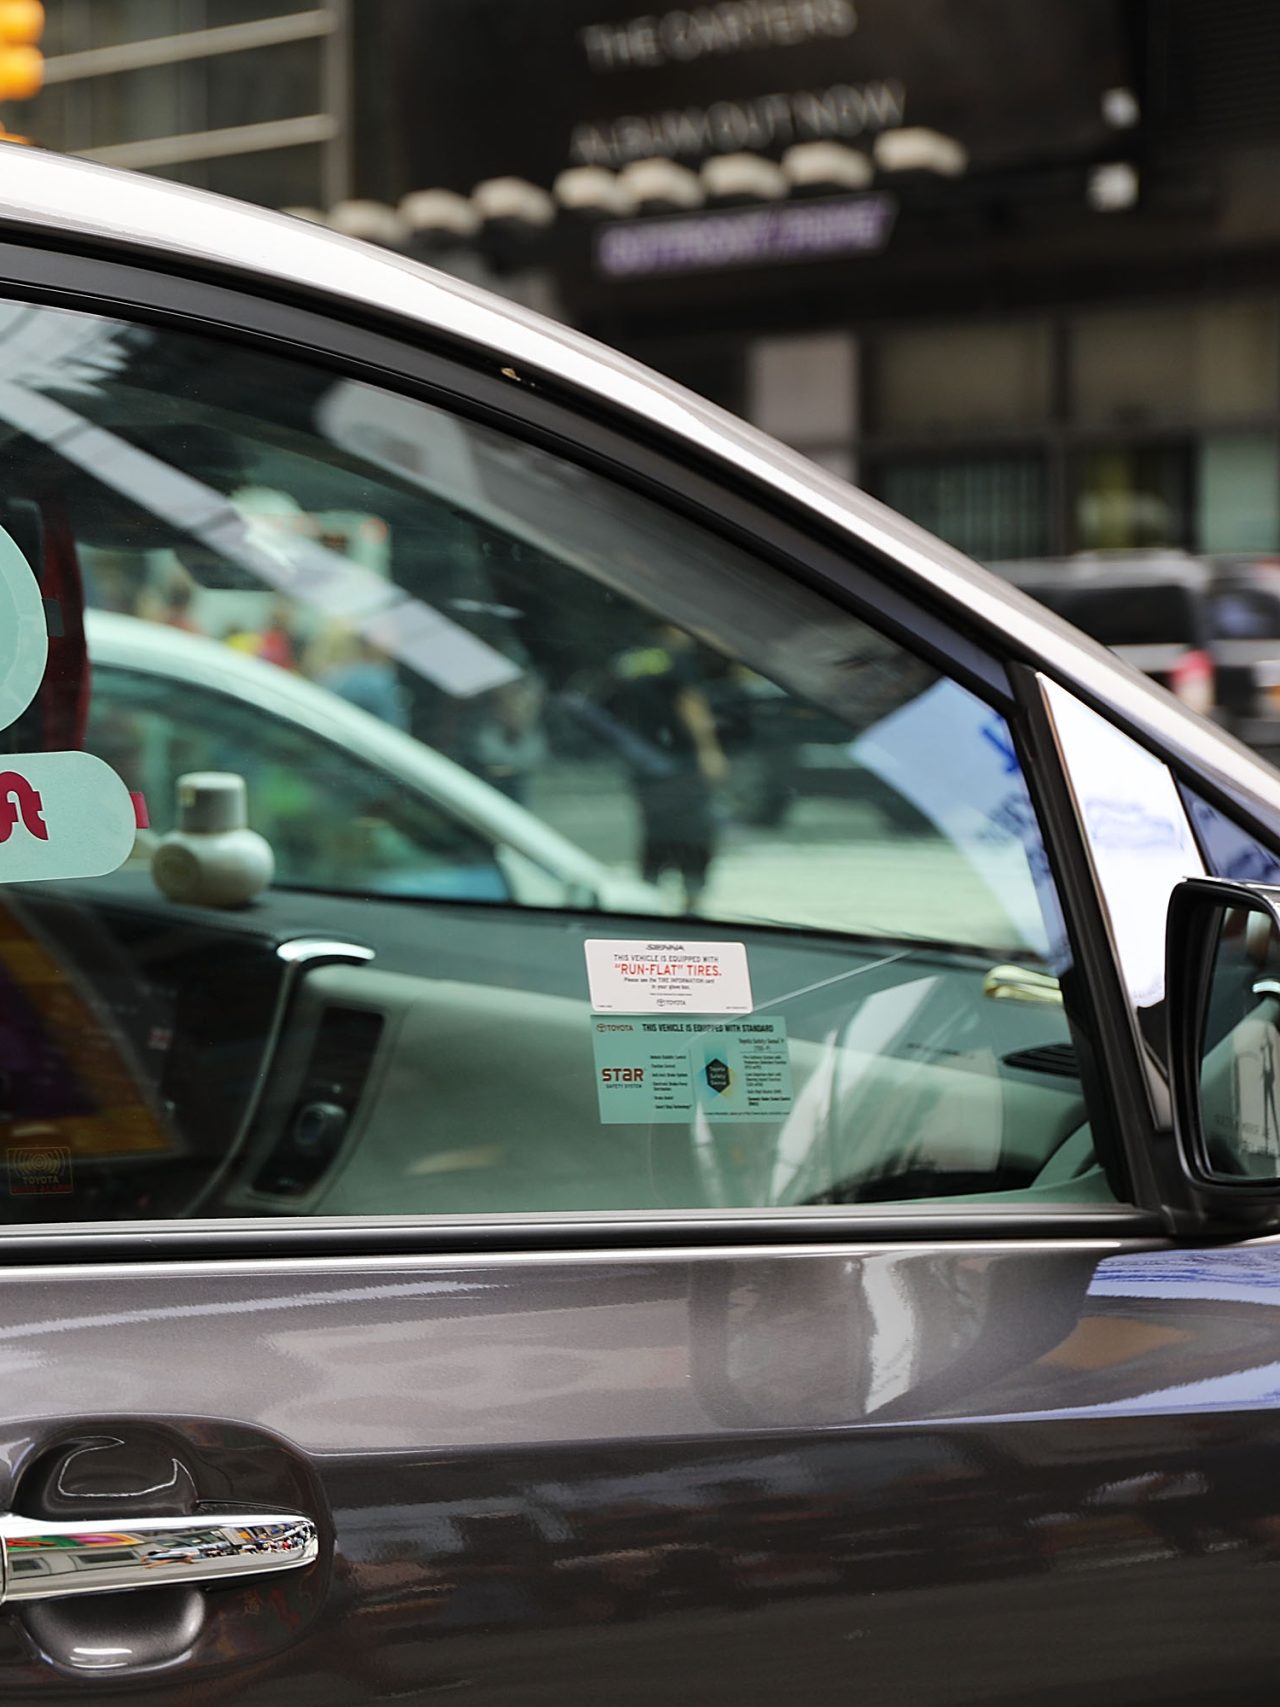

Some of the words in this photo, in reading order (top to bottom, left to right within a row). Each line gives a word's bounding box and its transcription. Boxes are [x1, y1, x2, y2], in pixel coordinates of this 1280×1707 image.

[583, 22, 664, 72] THE
[660, 0, 858, 61] CARTERS
[571, 107, 705, 167] ALBUM
[705, 93, 793, 150] OUT
[792, 79, 907, 138] NOW
[614, 954, 629, 962] THIS
[631, 954, 658, 962] VEHICLE
[669, 955, 701, 963] EQUIPPED
[687, 964, 722, 977] TIRES.
[642, 1023, 657, 1032] THIS
[658, 1023, 684, 1032] VEHICLE
[685, 1024, 692, 1032] IS
[693, 1024, 724, 1033] EQUIPPED
[725, 1024, 740, 1033] WITH
[742, 1024, 774, 1033] STANDARD
[22, 1175, 60, 1185] TOYOTA
